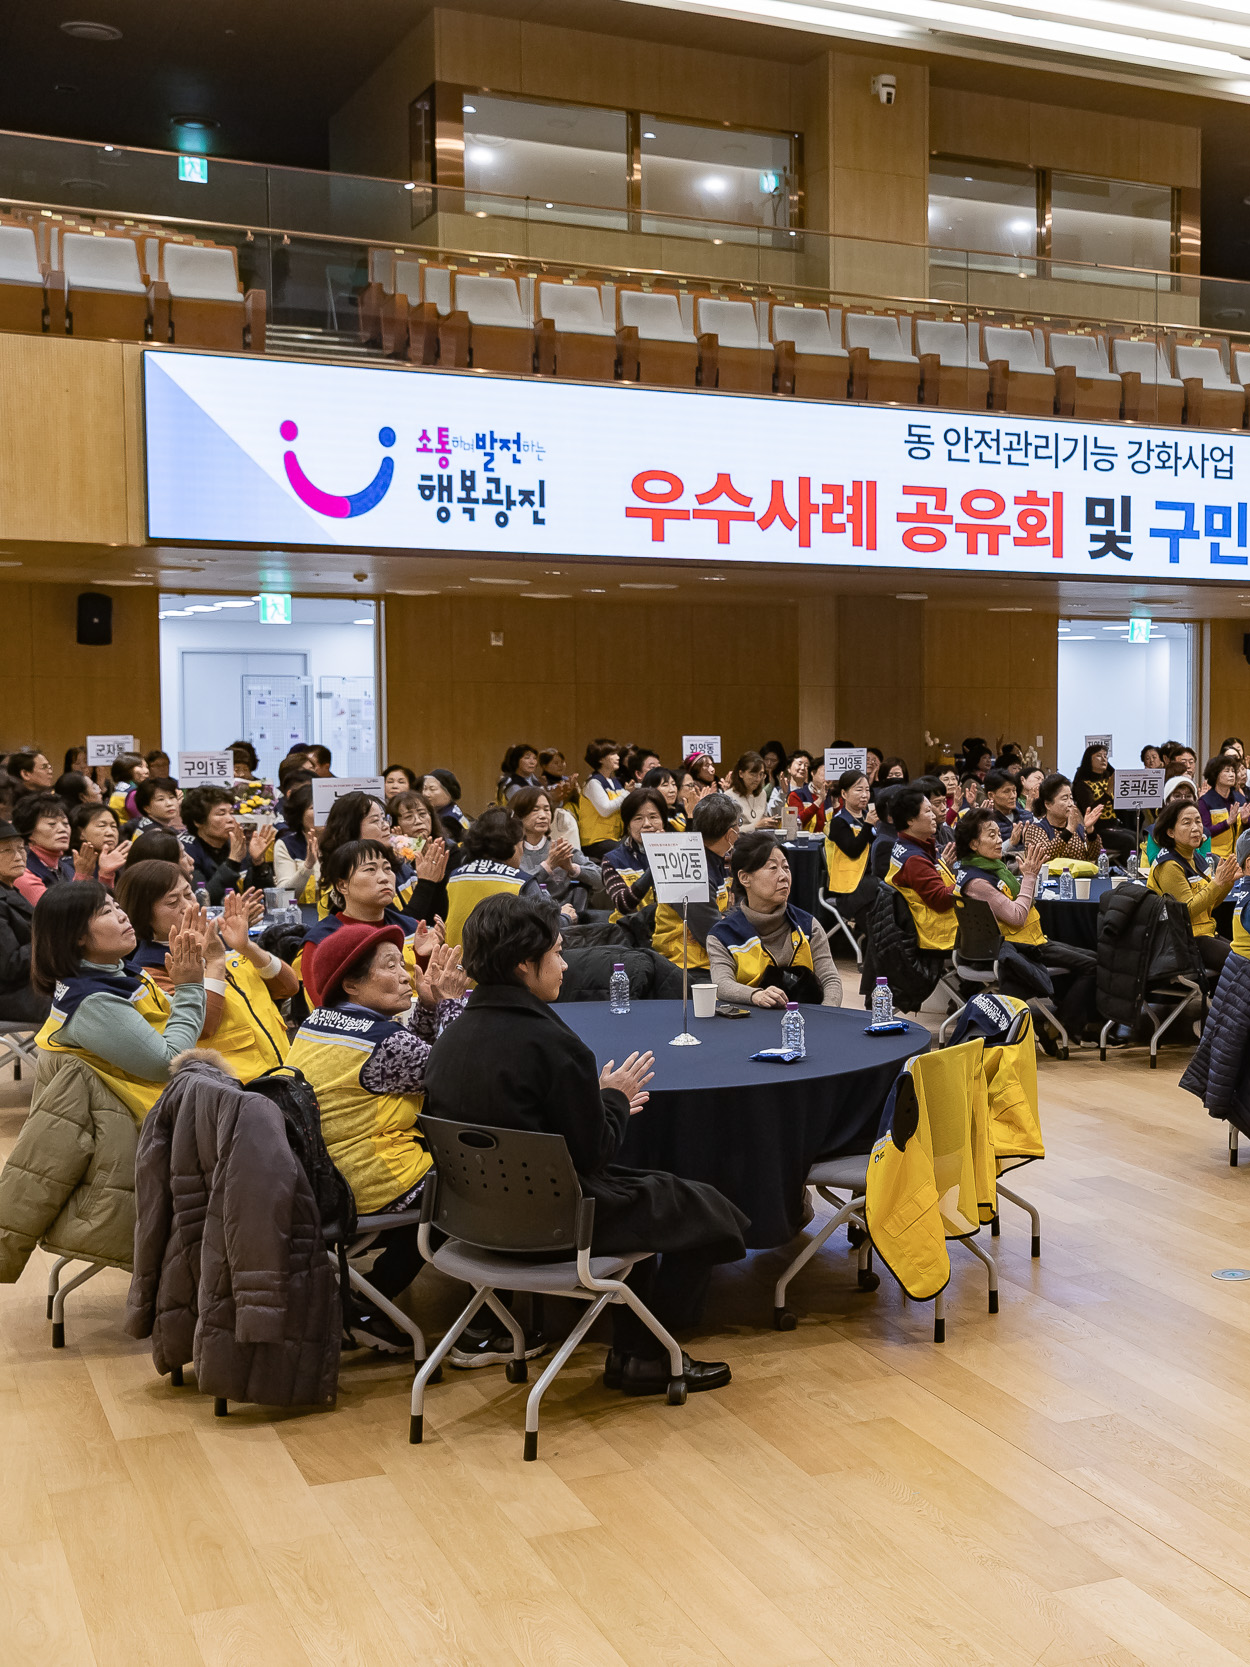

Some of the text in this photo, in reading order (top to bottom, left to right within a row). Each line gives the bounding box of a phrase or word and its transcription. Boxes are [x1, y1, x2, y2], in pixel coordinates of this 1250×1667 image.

[416, 426, 546, 472] 소통하며 발전하는
[903, 423, 1235, 481] 동 안전관리기능 강화사업
[417, 469, 546, 528] 행복광진
[625, 469, 878, 551] 우수사례
[896, 484, 1064, 559] 공유회
[1085, 494, 1134, 562] 및
[1149, 500, 1249, 566] 구민
[184, 760, 228, 776] 구의1동
[829, 756, 863, 771] 구의3동
[1119, 780, 1159, 796] 중곡4동
[654, 852, 702, 880] 구의2동
